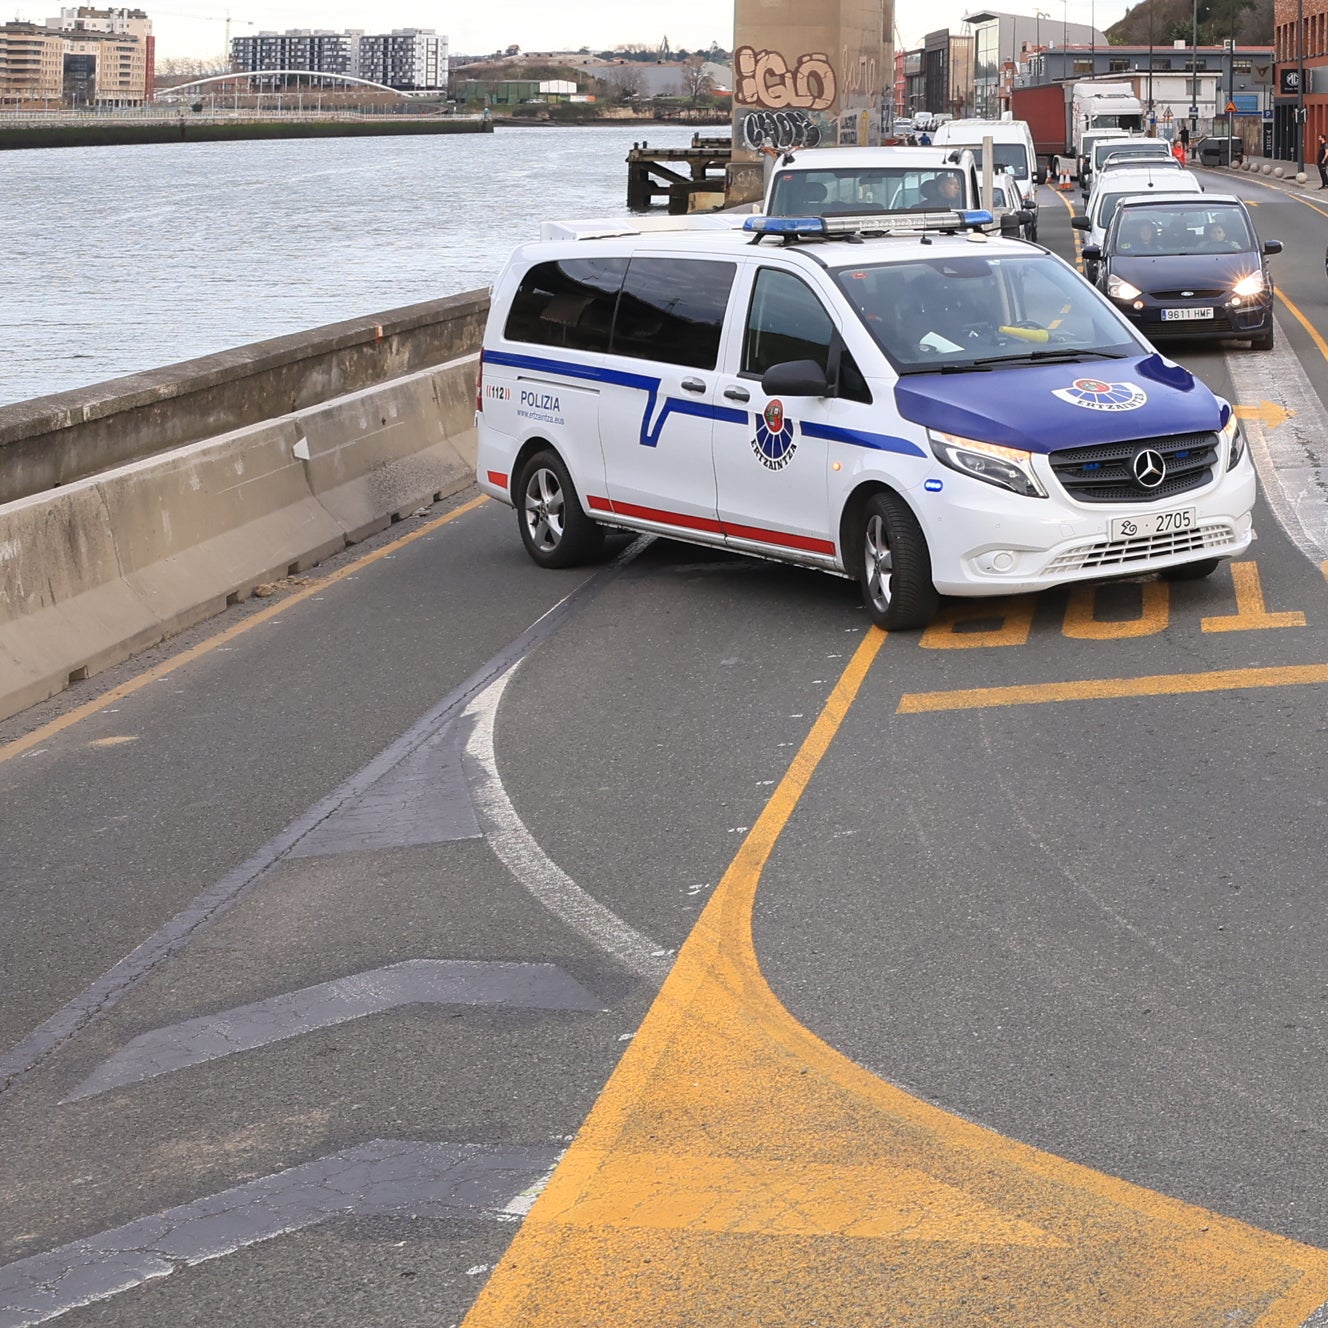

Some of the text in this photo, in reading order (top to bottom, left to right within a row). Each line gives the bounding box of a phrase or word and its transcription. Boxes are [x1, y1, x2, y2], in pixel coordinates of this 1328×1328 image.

[1167, 308, 1212, 320] 9611 HMF
[492, 387, 505, 399] 112
[520, 390, 561, 412] POLIZIA
[1077, 393, 1145, 410] ERTZAINTZA
[517, 409, 565, 425] www.ertzaintza.eus
[750, 438, 799, 471] ERTZAINTZA
[1156, 510, 1191, 533] 2705
